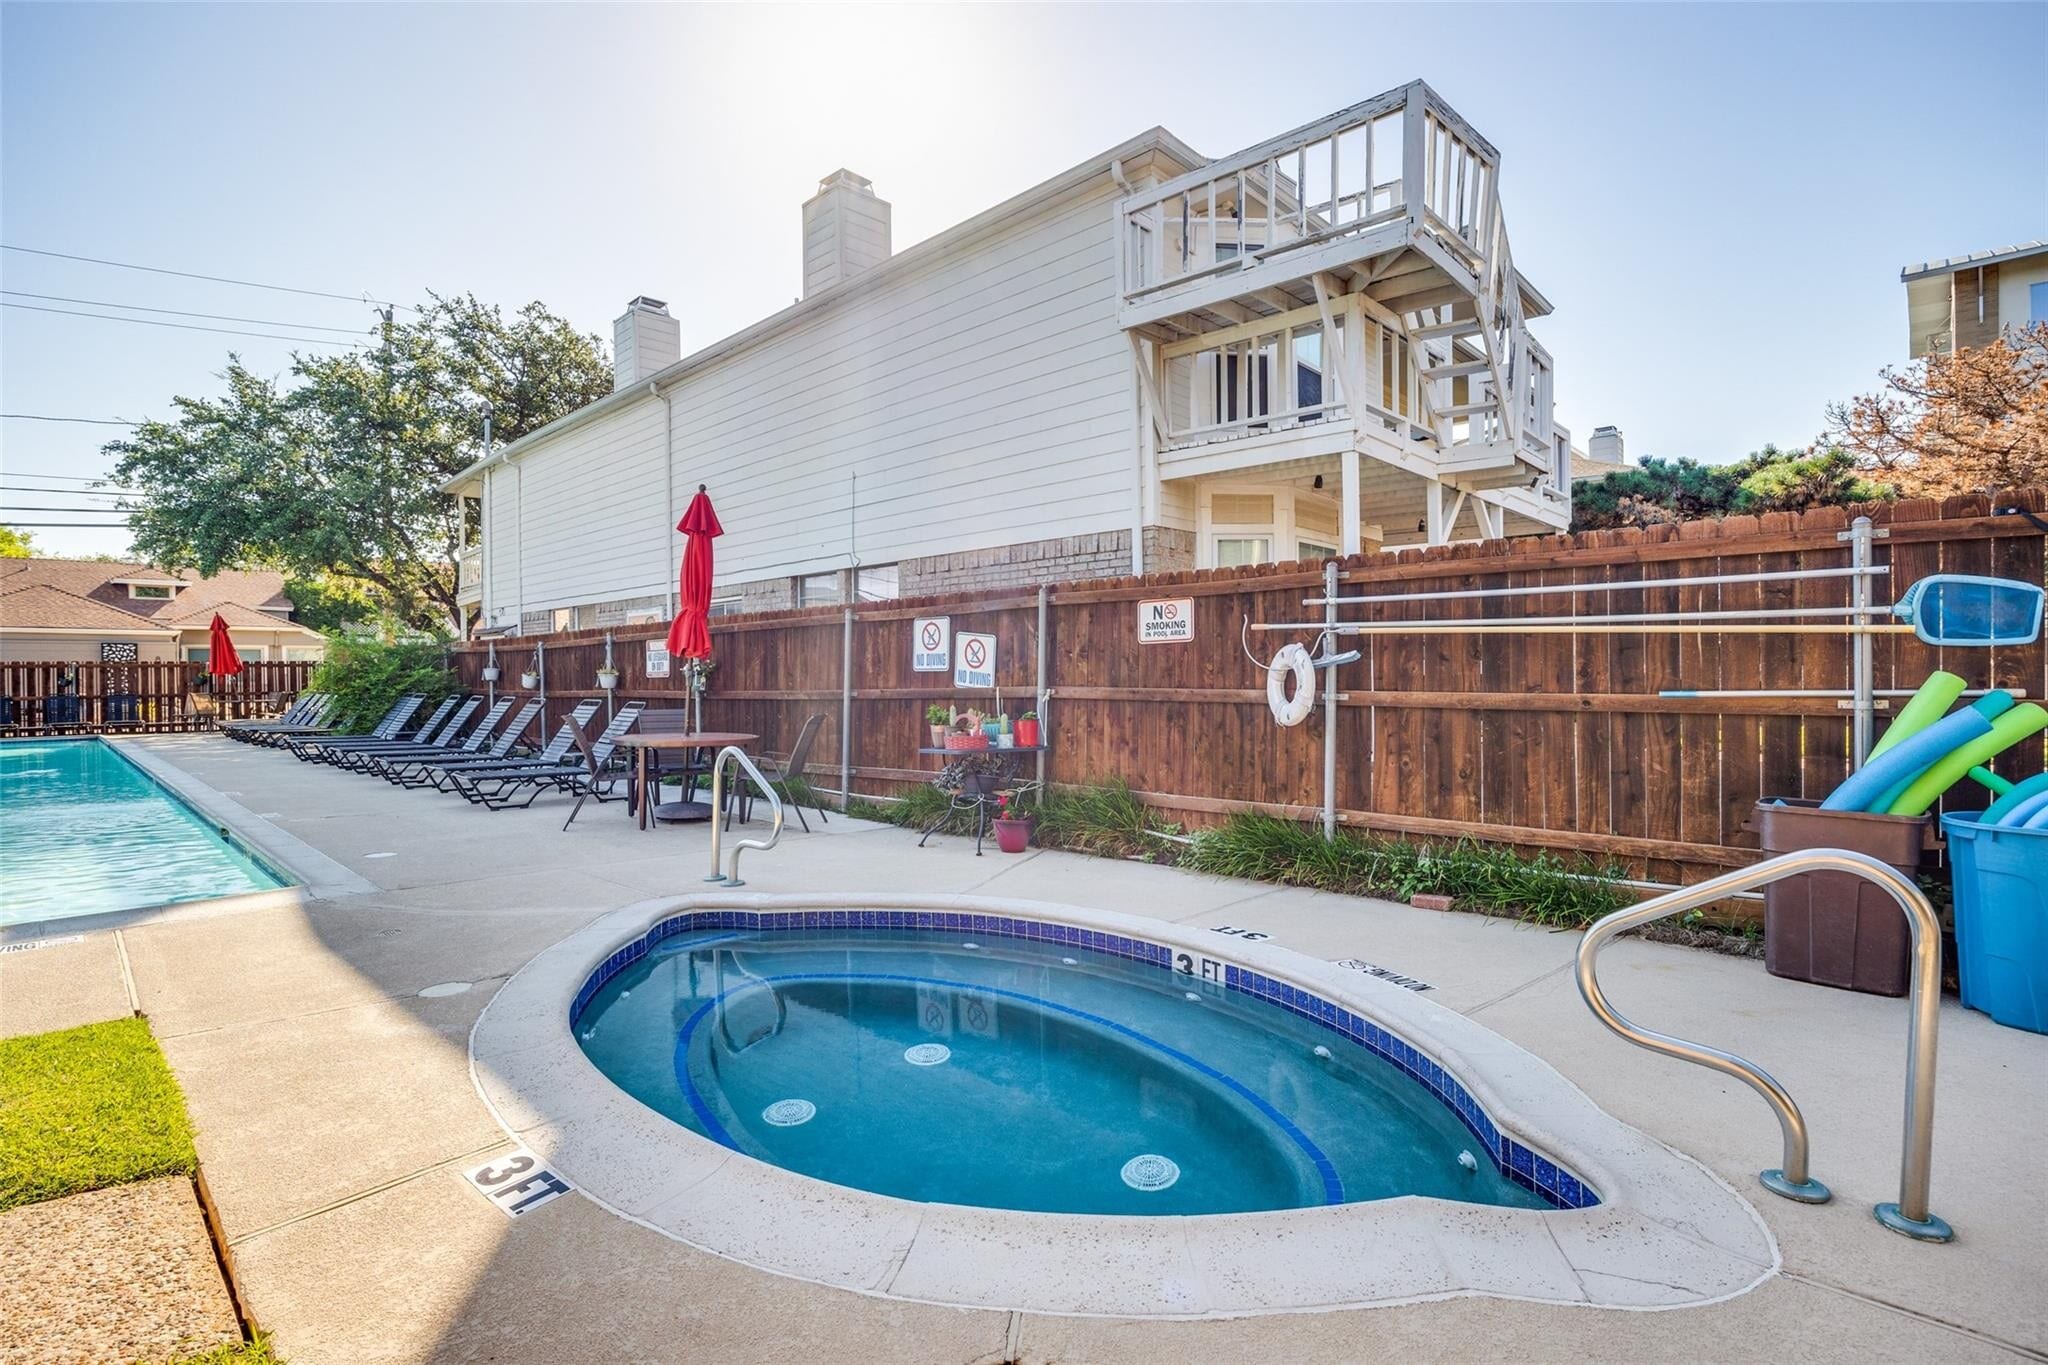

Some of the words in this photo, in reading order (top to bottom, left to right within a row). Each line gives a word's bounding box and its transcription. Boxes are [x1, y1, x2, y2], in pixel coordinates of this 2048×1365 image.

[1145, 620, 1186, 631] SMOKING
[916, 653, 924, 666] NO
[926, 653, 946, 666] DIVING
[957, 669, 967, 683] NO
[968, 671, 991, 687] DIVING
[1210, 926, 1246, 935] FT
[1241, 932, 1268, 940] 3
[1176, 953, 1194, 976] 3
[1202, 958, 1221, 982] FT
[475, 1156, 535, 1186] 3
